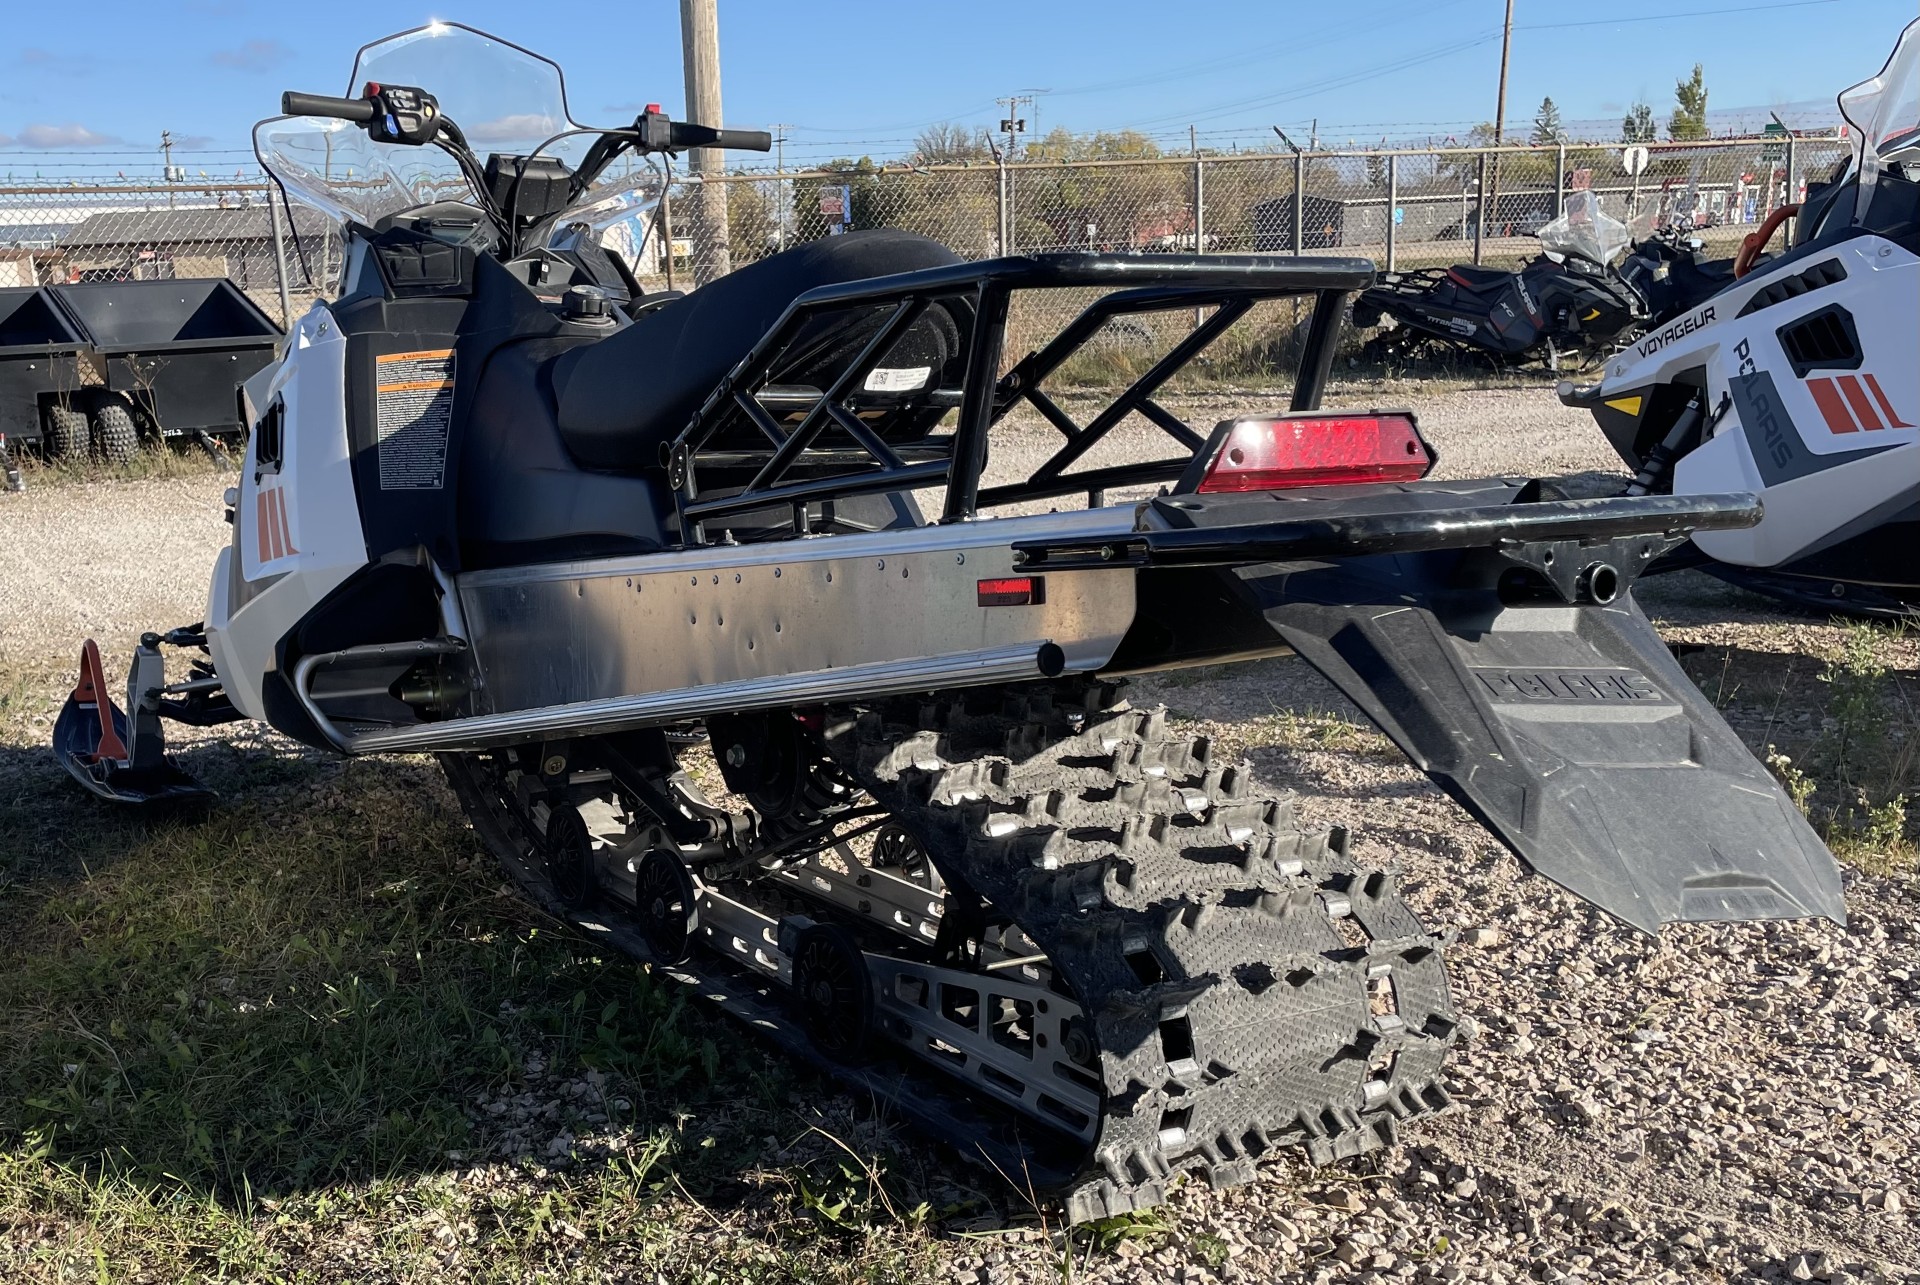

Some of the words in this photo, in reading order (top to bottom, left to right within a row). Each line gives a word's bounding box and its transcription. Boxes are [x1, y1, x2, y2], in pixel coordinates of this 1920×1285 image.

[1515, 274, 1537, 315] POLARIS
[1426, 315, 1452, 327] TITAN
[1637, 305, 1717, 359] VOYAGEUR
[1733, 337, 1794, 469] POLARIS
[1475, 672, 1662, 700] POLARIS
